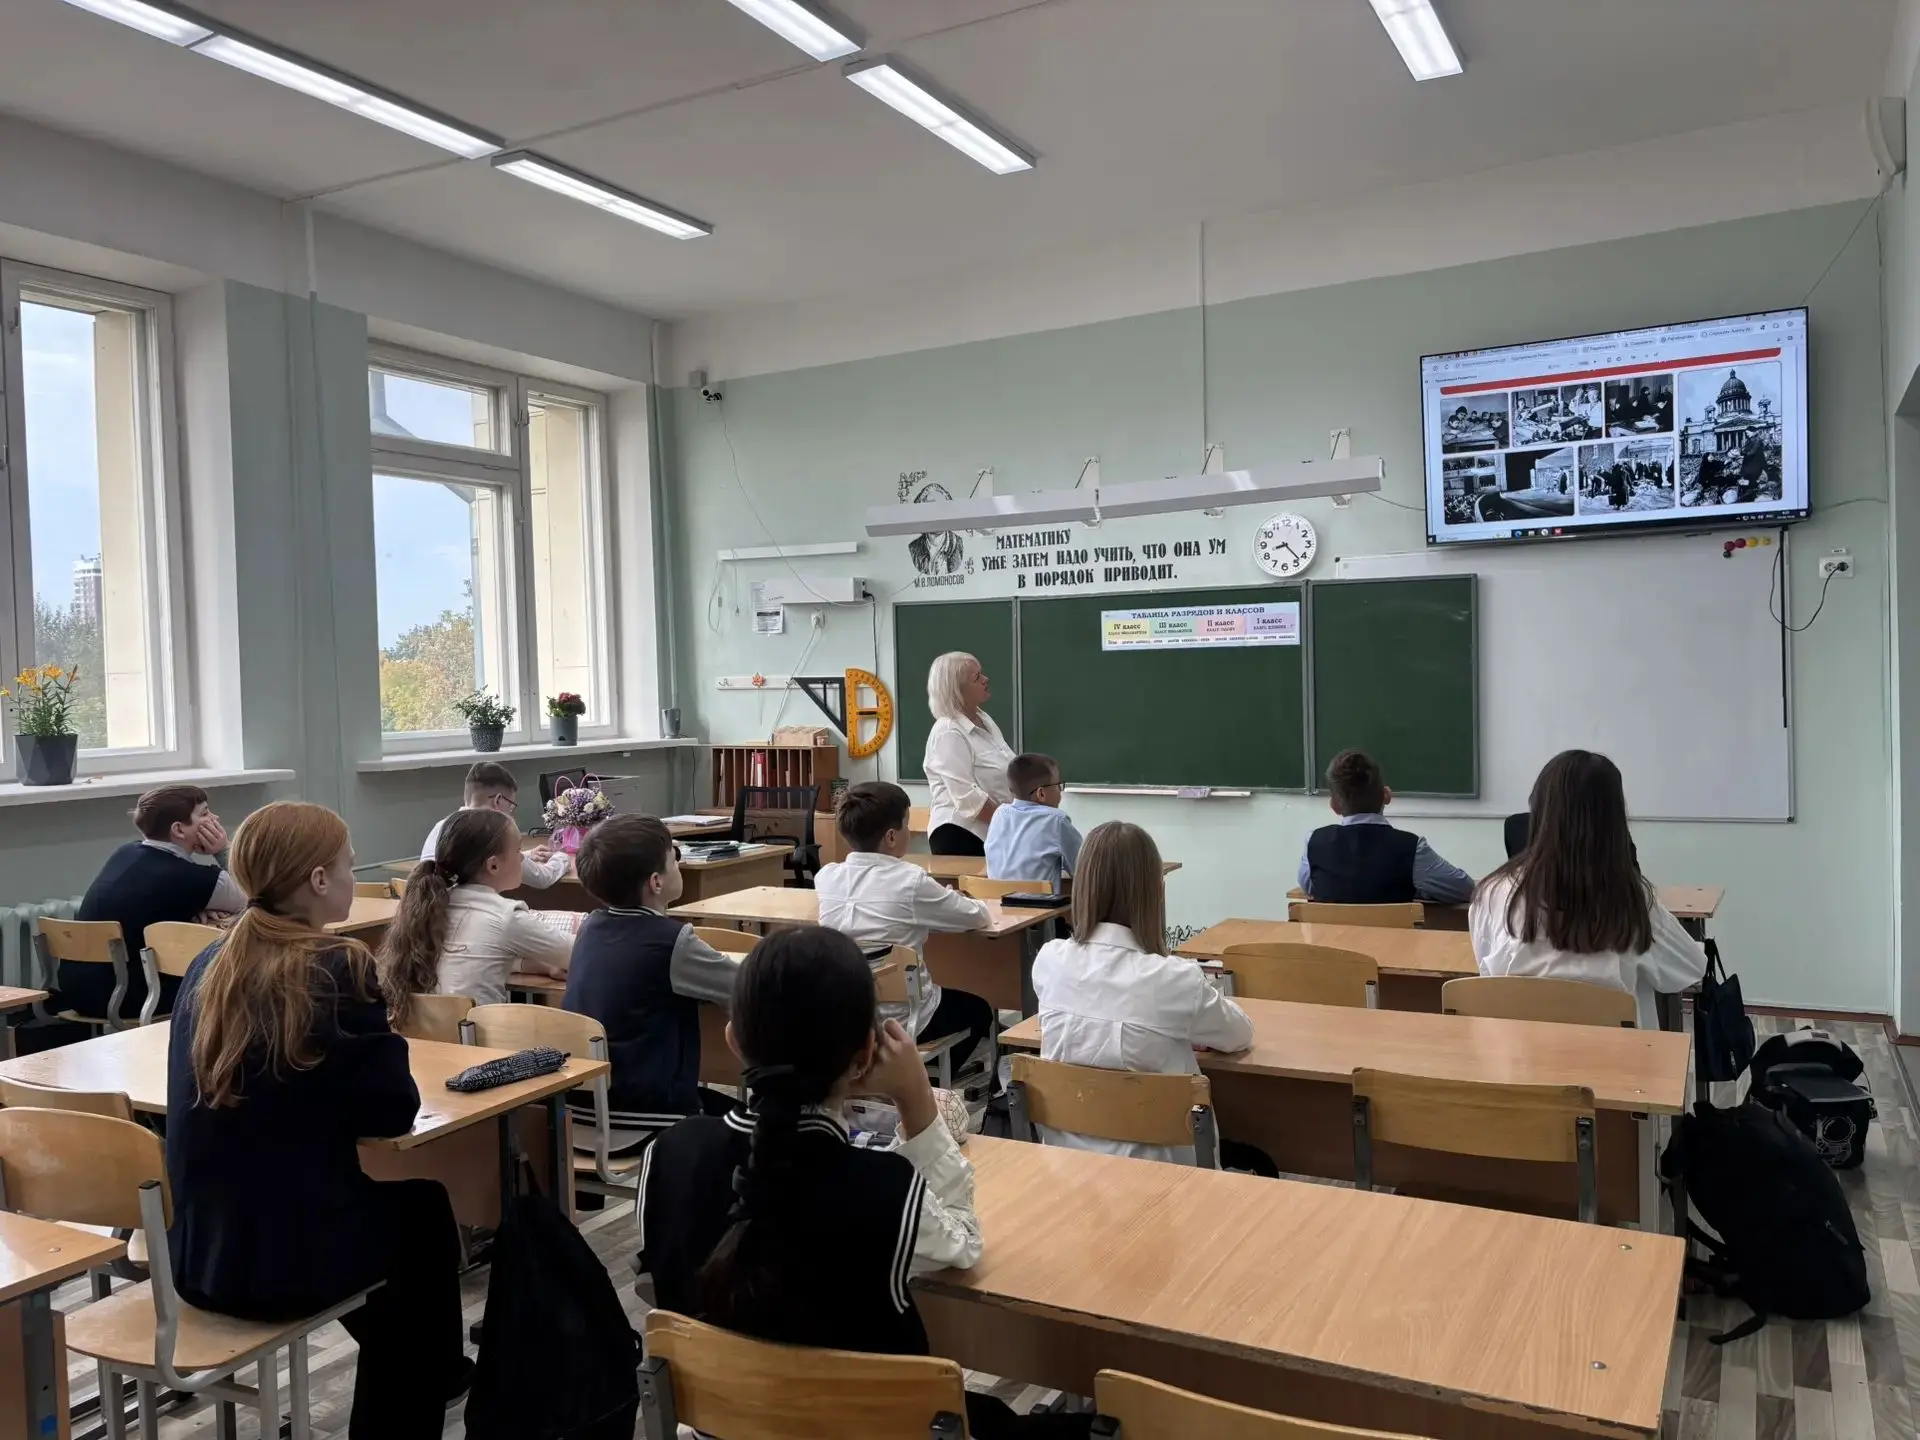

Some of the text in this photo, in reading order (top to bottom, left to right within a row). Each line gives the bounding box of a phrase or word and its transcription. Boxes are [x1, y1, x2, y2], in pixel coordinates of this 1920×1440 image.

[1272, 522, 1279, 530] 11
[1281, 519, 1291, 527] 12
[1296, 522, 1300, 530] 1
[1264, 530, 1273, 539] 10
[1301, 530, 1308, 538] 2
[996, 529, 1071, 550] МАТЕМАТИКУ
[1260, 541, 1267, 549] 9
[1305, 540, 1311, 548] 3
[982, 538, 1226, 571] УЖЕ ЗАТЕМ НАДО УЧИТЬ, ЧТО ОНА УМ
[1263, 552, 1270, 560] 8
[1300, 551, 1307, 559] 4
[1272, 560, 1278, 568] 7
[1281, 563, 1288, 571] 6
[1018, 564, 1178, 588] В ПОРЯДОК ПРИВОДИТ.
[1131, 611, 1169, 619] ТАБЛИЦА
[1171, 609, 1214, 618] РАЗРЯДОВ
[1225, 606, 1265, 615] КЛАССОВ
